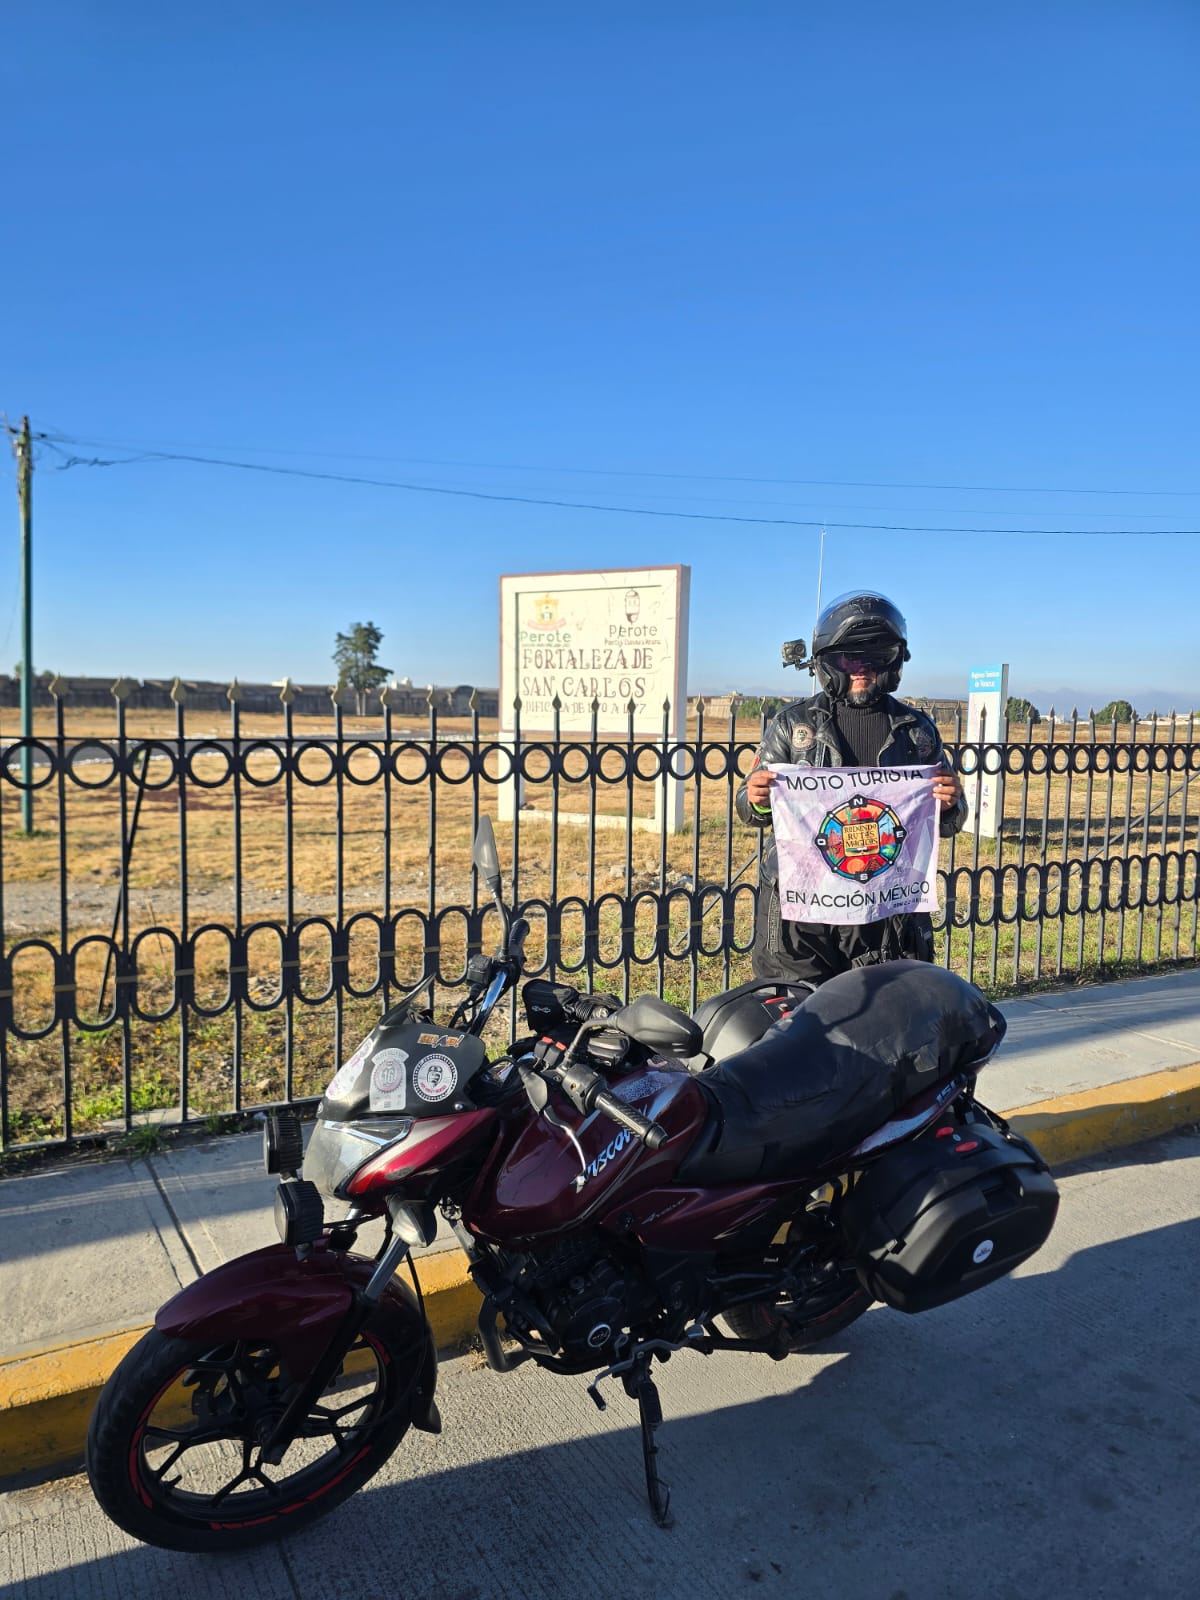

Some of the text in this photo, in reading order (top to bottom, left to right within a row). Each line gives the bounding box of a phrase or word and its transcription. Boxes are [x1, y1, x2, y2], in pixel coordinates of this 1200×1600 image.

[520, 630, 572, 643] Perote
[608, 624, 658, 638] Perote
[522, 647, 654, 670] FORTALEZA DE
[522, 675, 647, 698] SAN CARLOS
[785, 775, 844, 790] MOTO
[853, 797, 863, 805] N
[896, 830, 904, 838] E
[860, 873, 868, 881] S
[786, 890, 806, 904] EN
[809, 890, 875, 908] ACCIÓN
[879, 880, 930, 903] MÉXICO
